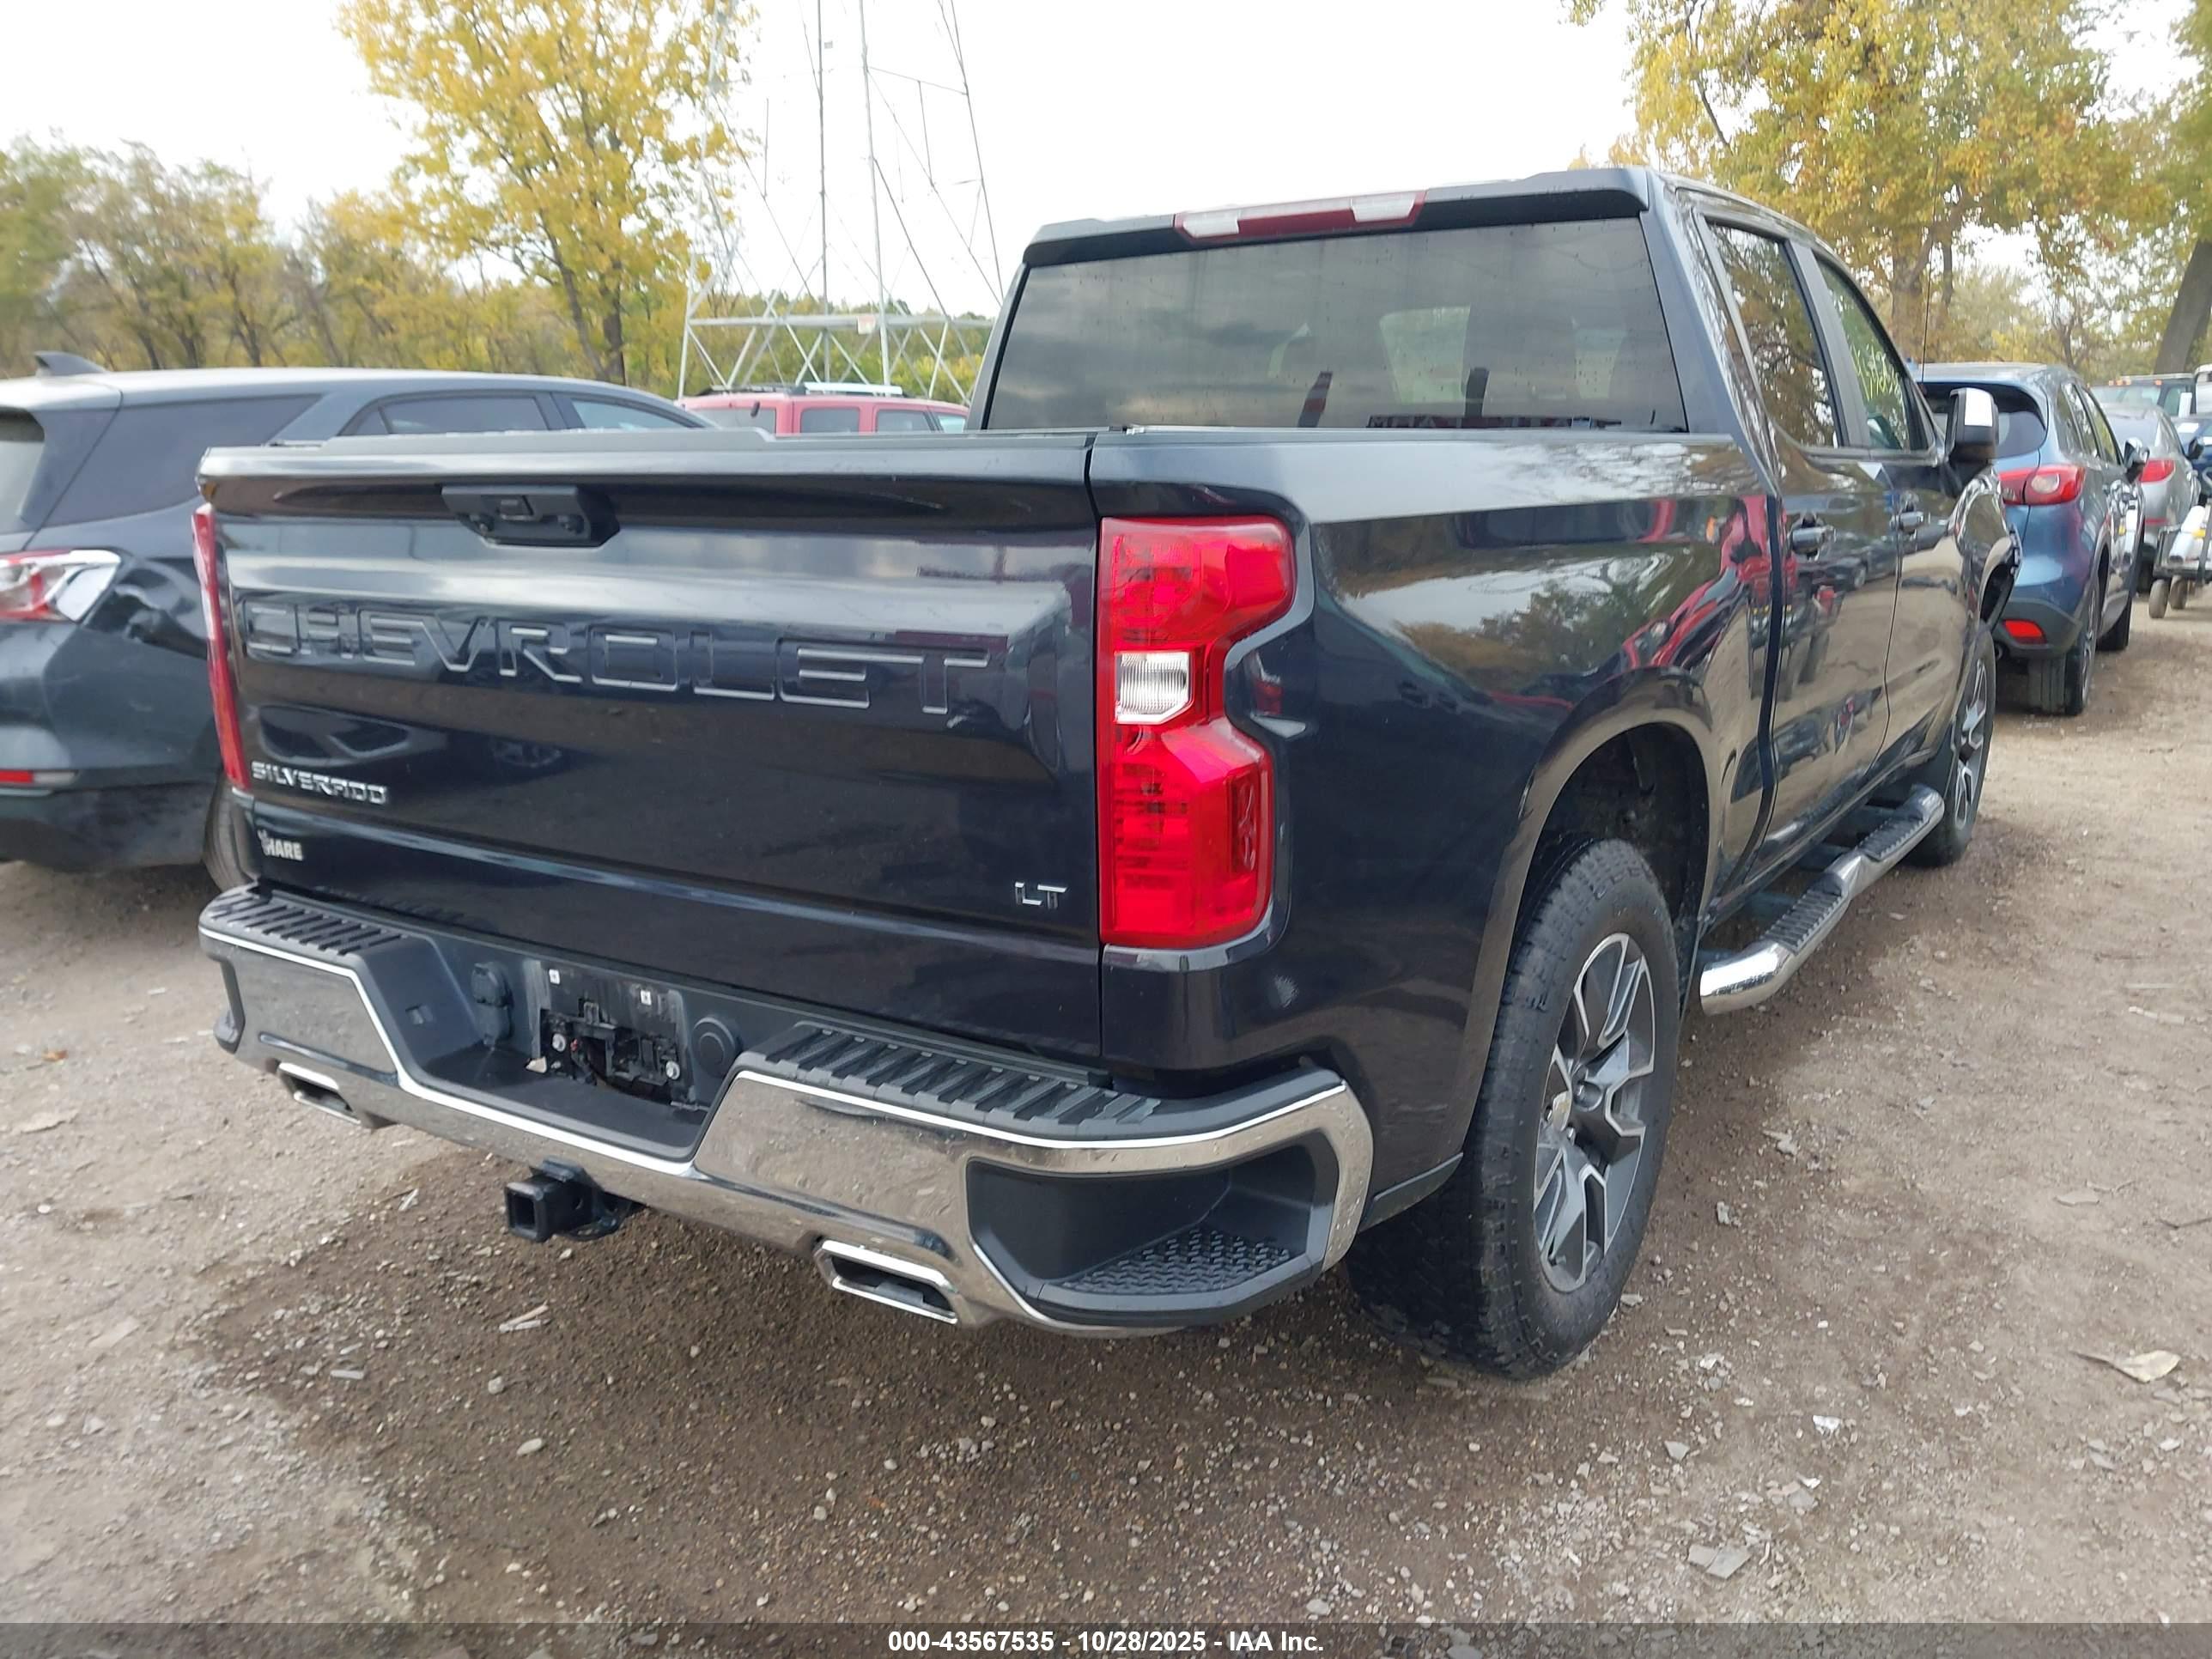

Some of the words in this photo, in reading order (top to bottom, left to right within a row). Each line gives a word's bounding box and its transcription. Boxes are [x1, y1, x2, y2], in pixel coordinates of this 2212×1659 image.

[242, 599, 989, 714] CHEVROLET
[251, 760, 388, 805] SILVERADO
[1014, 882, 1067, 909] LT
